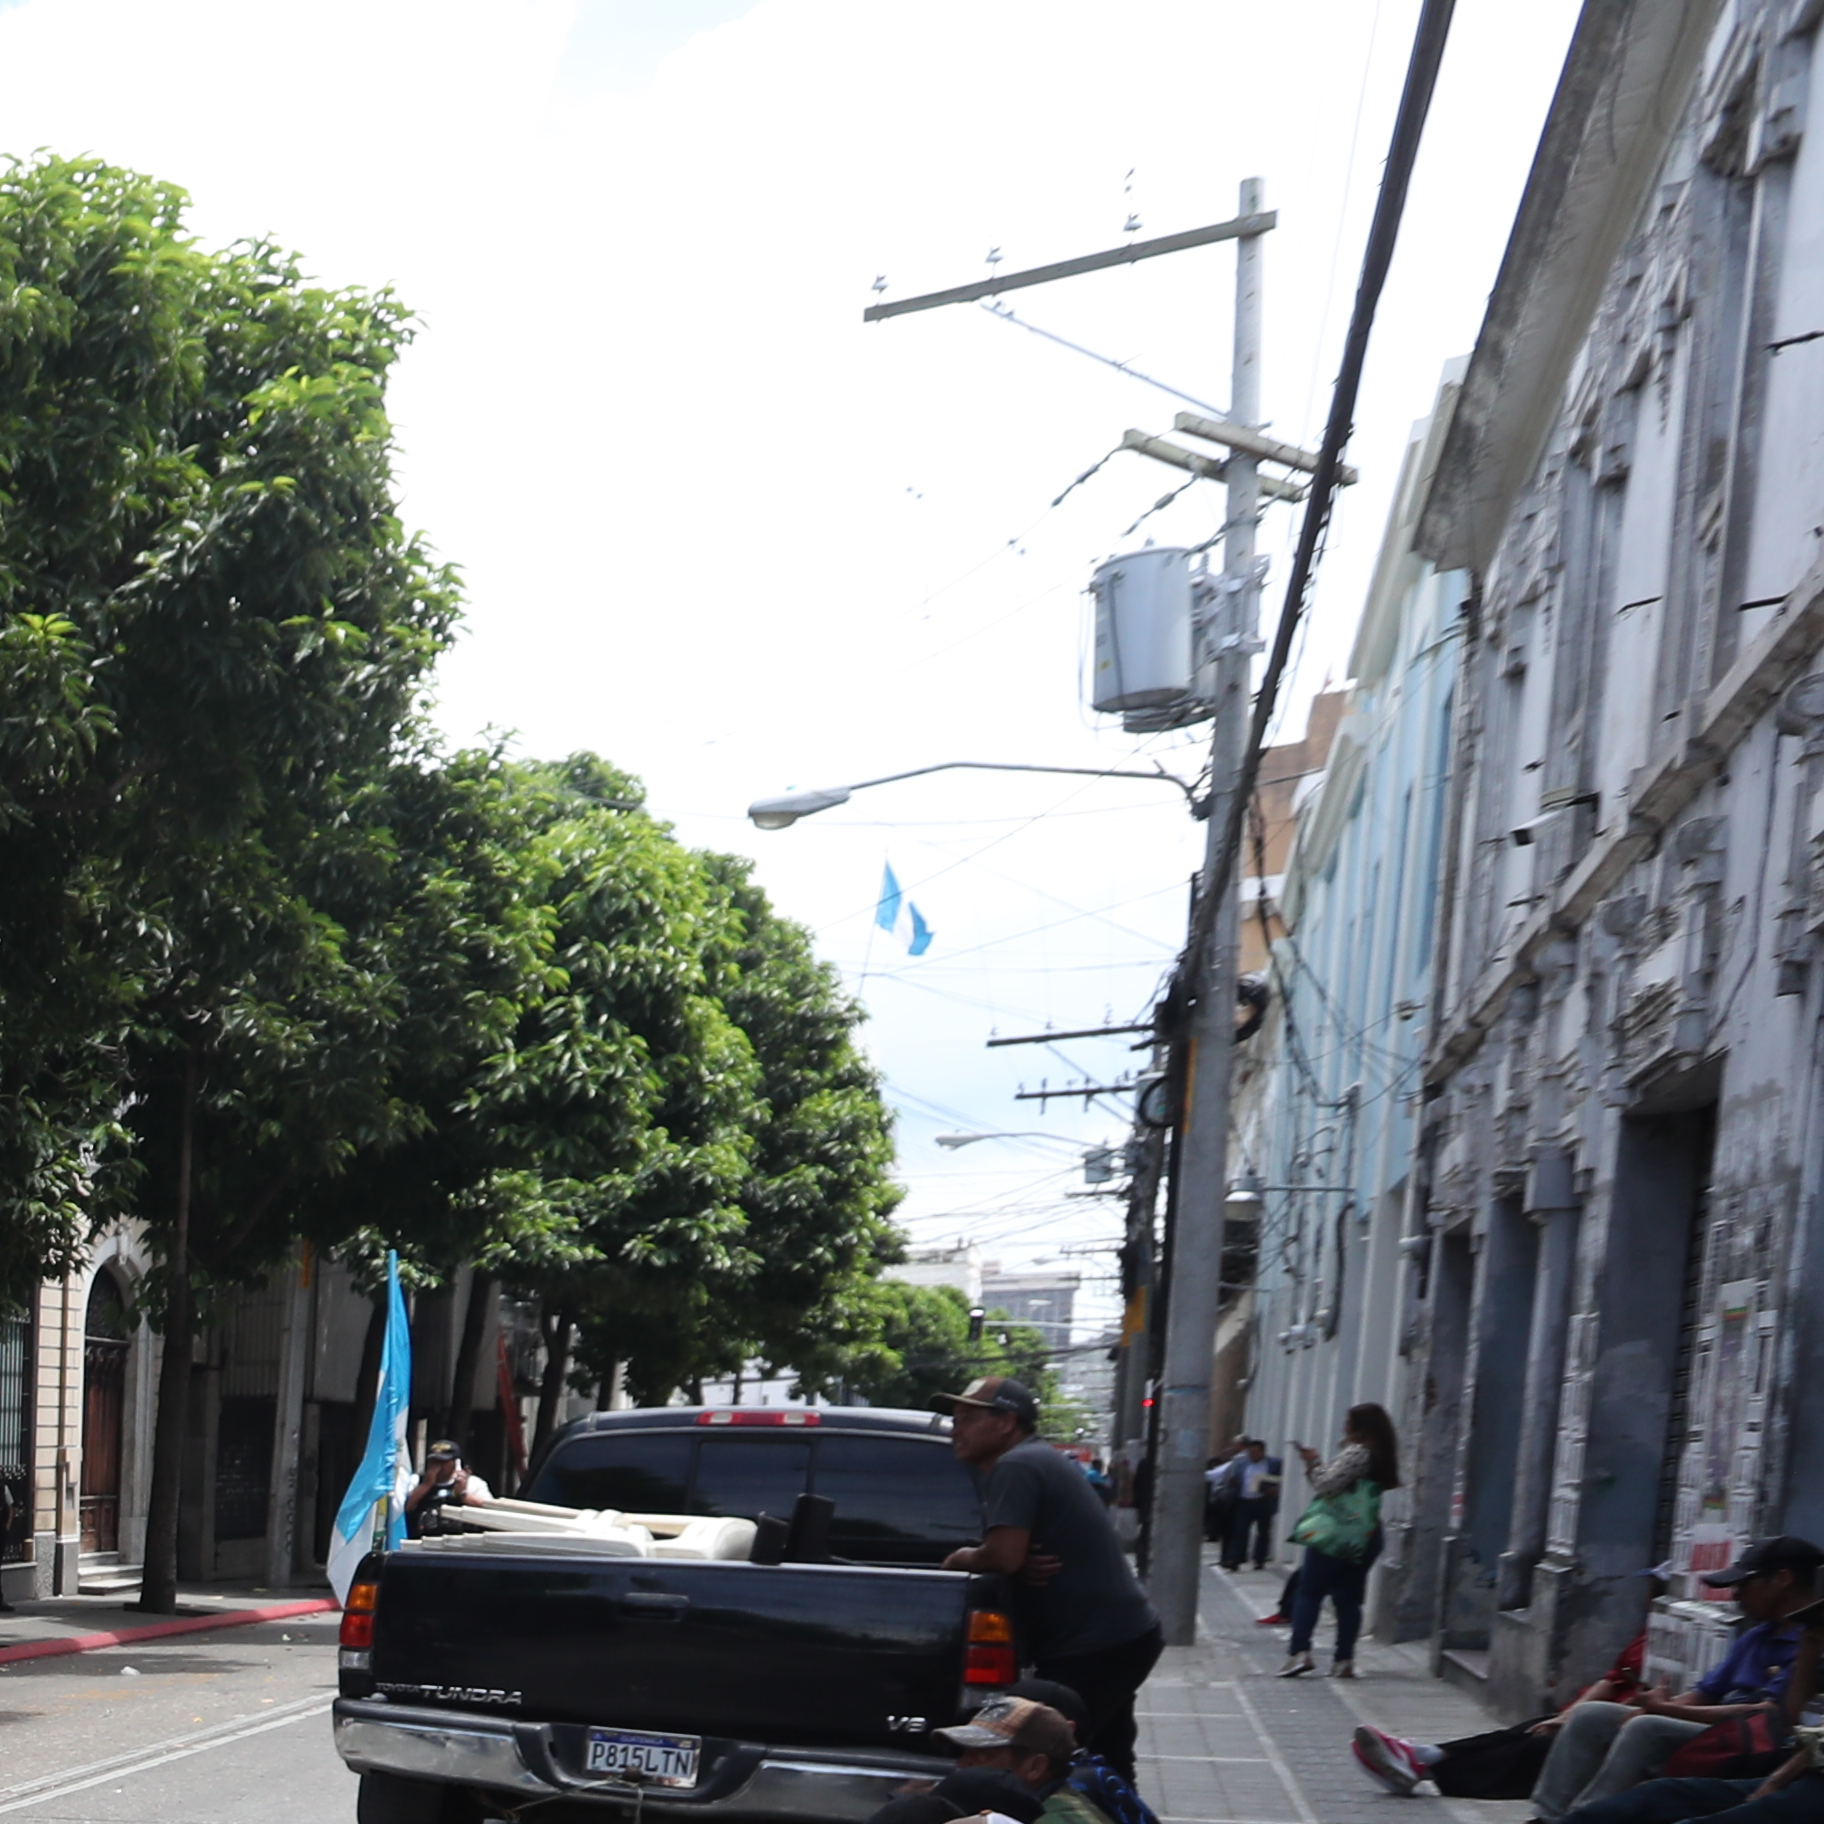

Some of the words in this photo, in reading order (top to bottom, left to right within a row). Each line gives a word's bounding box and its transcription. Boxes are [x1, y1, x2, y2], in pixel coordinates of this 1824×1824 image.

[376, 1682, 420, 1693] TOYOTA
[420, 1684, 522, 1705] TUNDRA
[887, 1715, 926, 1732] V8
[592, 1742, 690, 1775] P815LTN
